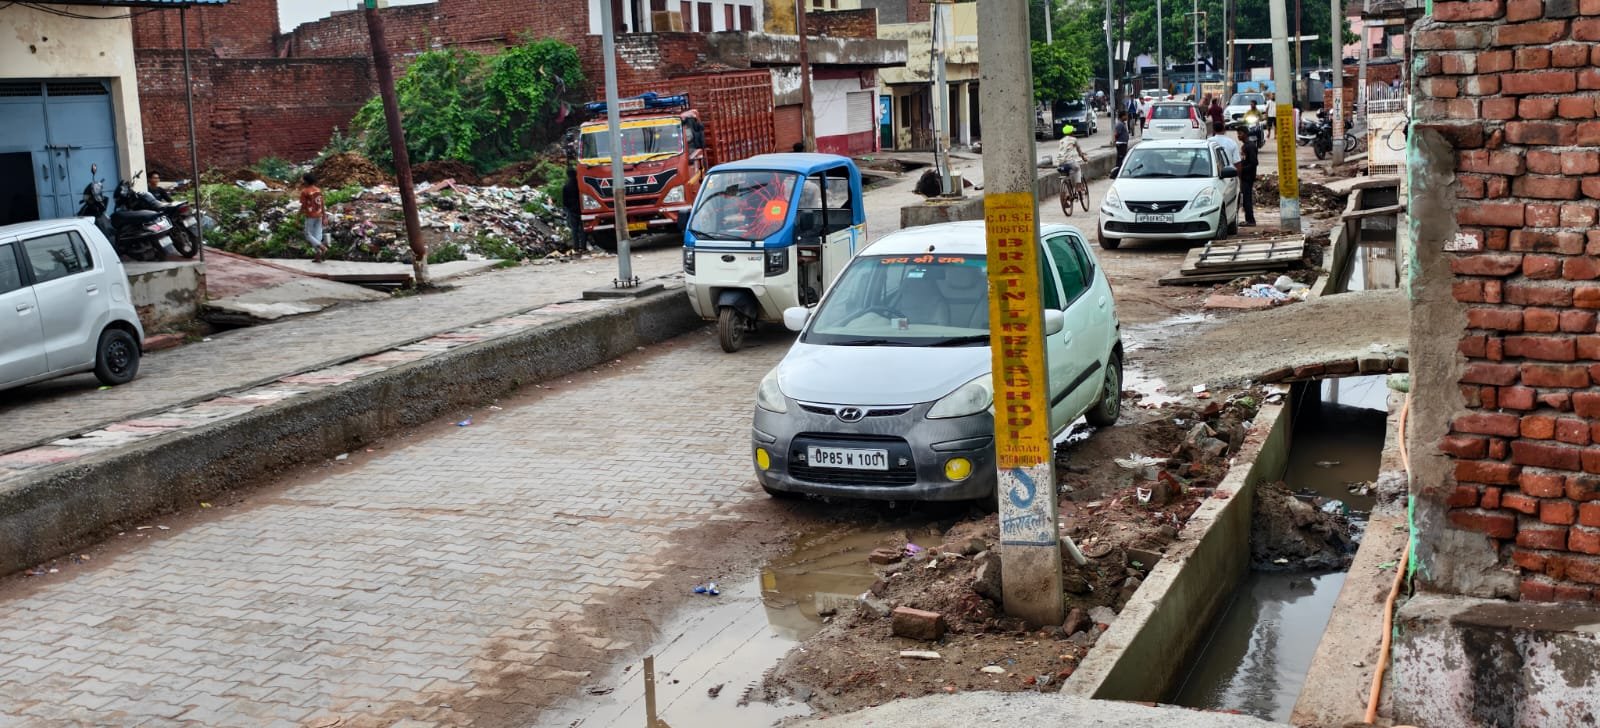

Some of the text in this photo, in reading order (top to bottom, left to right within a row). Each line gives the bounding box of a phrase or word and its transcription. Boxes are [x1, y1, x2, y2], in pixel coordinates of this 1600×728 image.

[913, 254, 934, 264] श्री
[938, 256, 965, 264] राम
[998, 238, 1026, 301] BRAIN
[1005, 364, 1032, 439] SCHOOL
[846, 453, 853, 465] W
[859, 452, 885, 467] 1001
